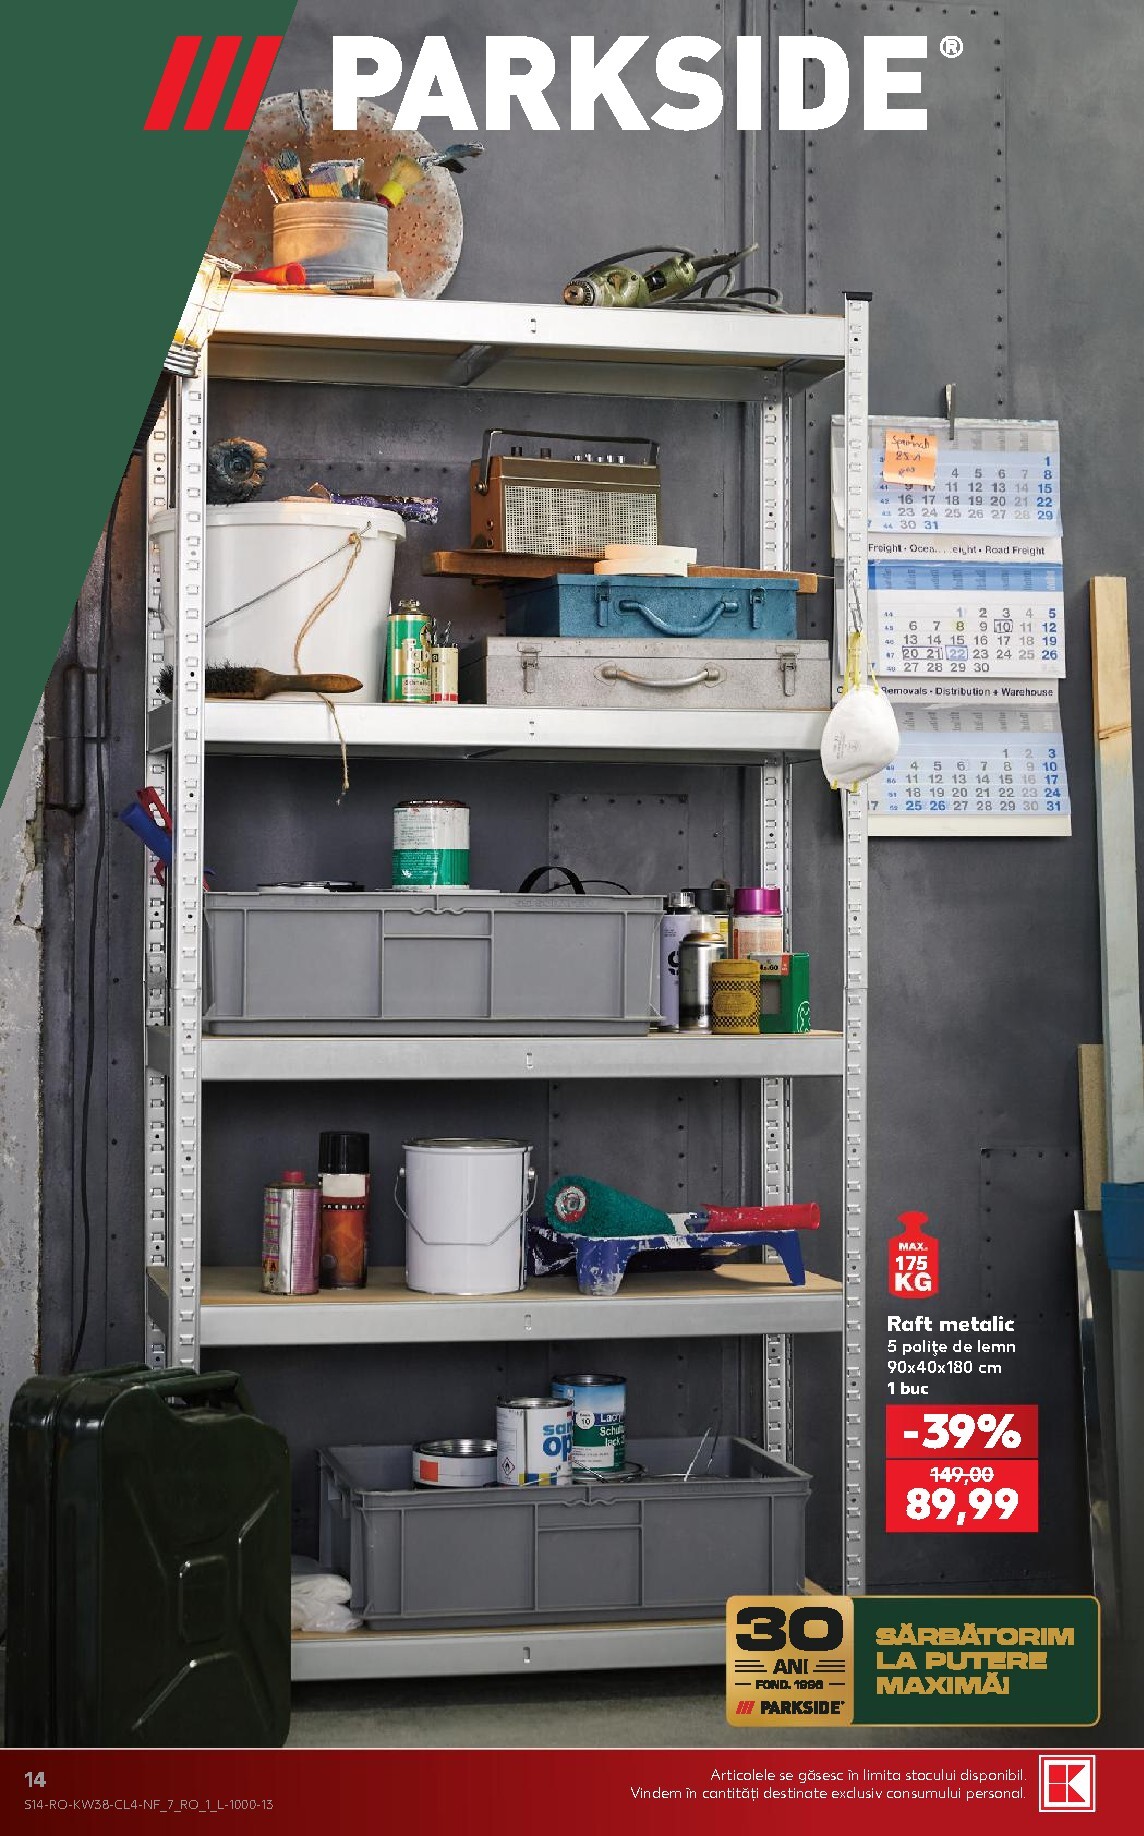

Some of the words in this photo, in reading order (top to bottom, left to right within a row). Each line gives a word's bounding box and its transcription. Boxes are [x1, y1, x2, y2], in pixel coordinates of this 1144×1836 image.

[1045, 457, 1051, 467] 1
[951, 468, 959, 478] 4
[974, 468, 982, 478] 5
[998, 468, 1006, 478] 6
[1021, 468, 1028, 478] 7
[1044, 470, 1052, 480] 8
[946, 483, 958, 493] 11
[968, 483, 982, 493] 12
[991, 483, 1006, 493] 13
[1014, 483, 1029, 493] 14
[1038, 484, 1052, 494] 15
[898, 496, 914, 506] 16
[922, 496, 936, 506] 17
[945, 496, 960, 506] 18
[968, 496, 982, 506] 19
[990, 496, 1006, 506] 20
[1037, 497, 1052, 507] 22
[898, 508, 915, 518] 23
[922, 508, 938, 518] 24
[945, 508, 961, 518] 25
[968, 508, 984, 518] 26
[992, 508, 1006, 518] 27
[1038, 510, 1053, 520] 29
[900, 520, 916, 530] 30
[924, 520, 939, 530] 31
[985, 546, 1010, 554] Road
[1012, 546, 1045, 556] Freight
[979, 608, 988, 618] 2
[1003, 608, 1011, 618] 3
[1049, 608, 1056, 618] 5
[909, 621, 917, 631] 6
[933, 621, 940, 631] 7
[956, 621, 965, 631] 8
[980, 621, 988, 631] 9
[996, 622, 1011, 632] 10
[1042, 623, 1057, 632] 12
[904, 636, 918, 645] 13
[927, 636, 942, 645] 14
[951, 636, 965, 645] 15
[974, 636, 988, 645] 16
[997, 636, 1011, 645] 17
[1042, 636, 1057, 646] 19
[904, 649, 918, 658] 20
[927, 649, 940, 658] 21
[950, 649, 966, 658] 22
[973, 649, 989, 658] 23
[996, 649, 1012, 658] 24
[1042, 650, 1058, 660] 26
[904, 662, 919, 672] 27
[927, 662, 942, 672] 28
[950, 662, 966, 672] 29
[974, 662, 990, 672] 30
[935, 687, 990, 696] Distribution
[1001, 688, 1053, 697] Warehouse
[1003, 748, 1009, 758] 1
[1048, 748, 1056, 758] 3
[910, 762, 918, 771] 4
[934, 762, 942, 771] 5
[957, 762, 965, 771] 6
[981, 762, 988, 771] 7
[1004, 762, 1012, 771] 8
[1043, 762, 1057, 772] 10
[906, 774, 918, 784] 11
[928, 774, 943, 784] 12
[952, 774, 966, 784] 13
[976, 774, 990, 784] 14
[999, 774, 1012, 784] 15
[1044, 775, 1058, 785] 17
[906, 788, 921, 798] 18
[930, 788, 944, 798] 19
[952, 788, 968, 798] 20
[976, 788, 990, 798] 21
[999, 788, 1014, 798] 22
[1044, 788, 1061, 798] 24
[906, 801, 922, 811] 25
[930, 801, 946, 811] 26
[953, 801, 968, 811] 27
[976, 801, 992, 811] 28
[1000, 801, 1016, 811] 29
[1046, 801, 1061, 811] 31
